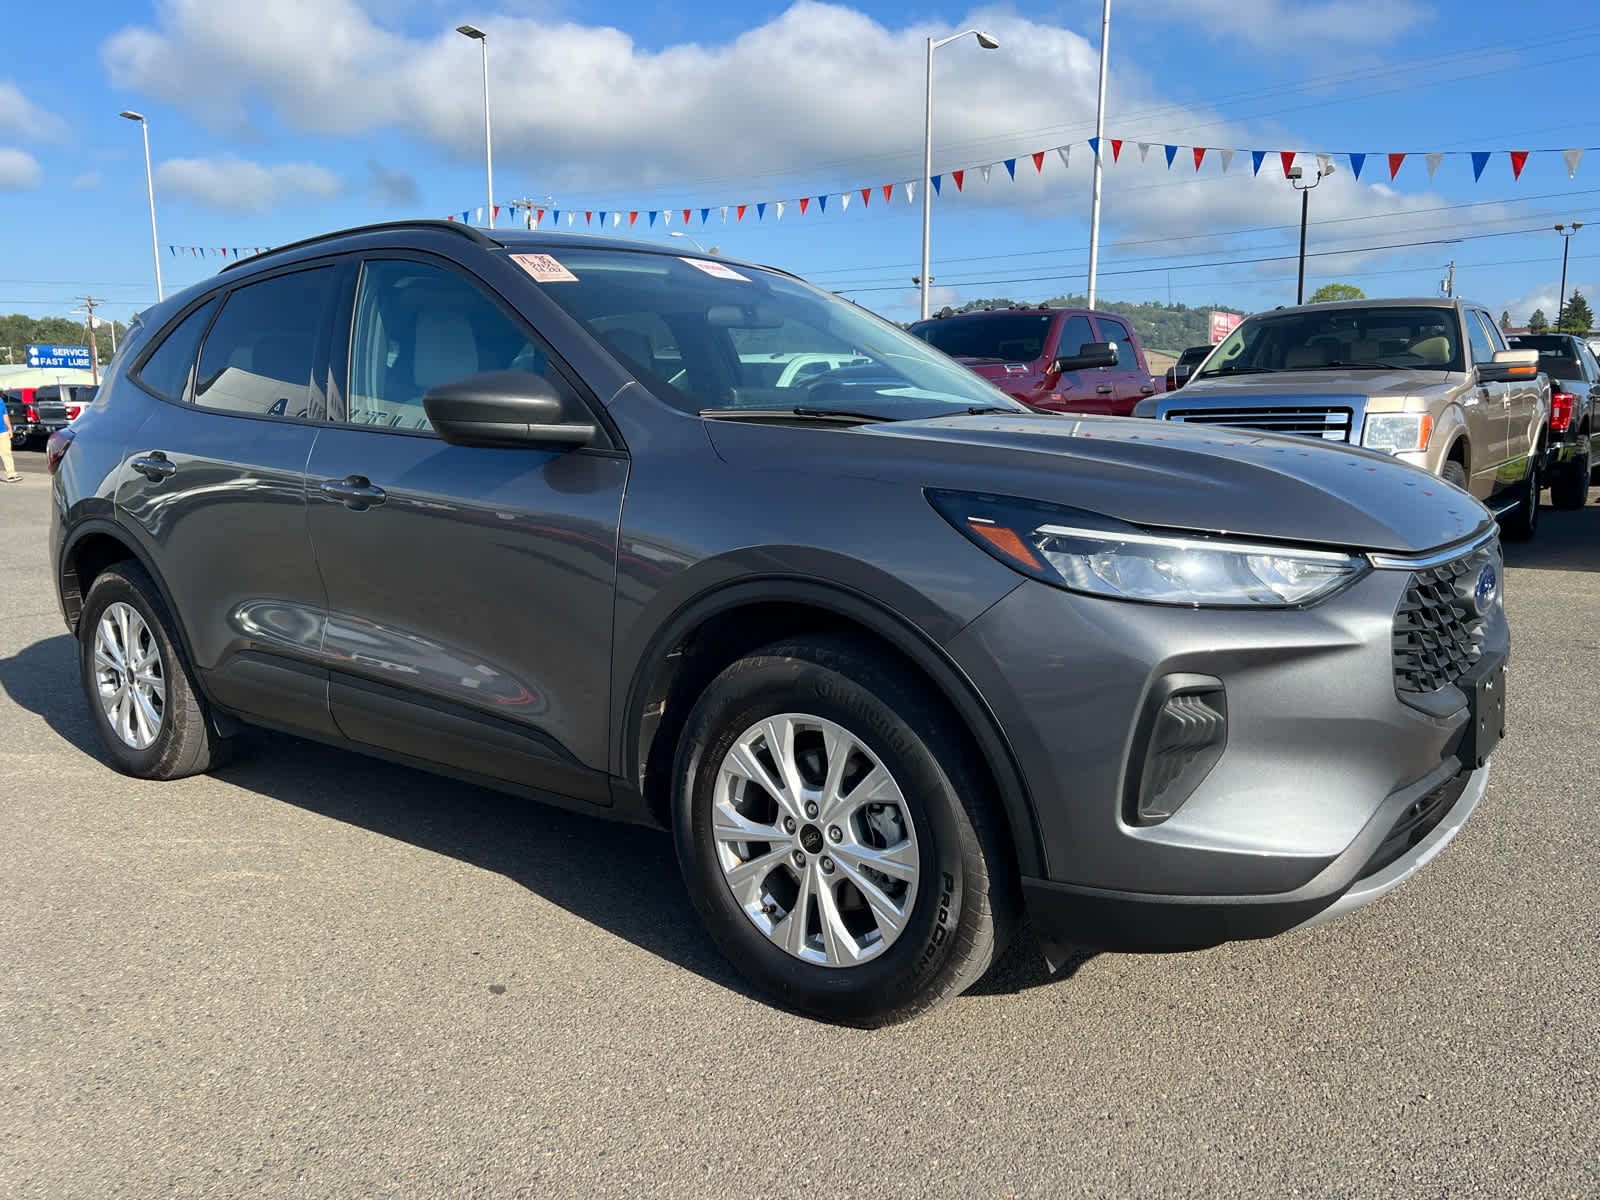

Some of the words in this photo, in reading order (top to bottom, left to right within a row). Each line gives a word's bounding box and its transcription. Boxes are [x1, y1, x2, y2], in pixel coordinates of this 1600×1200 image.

[53, 348, 89, 356] SERVICE
[40, 357, 63, 366] FAST
[68, 358, 90, 366] LUBE
